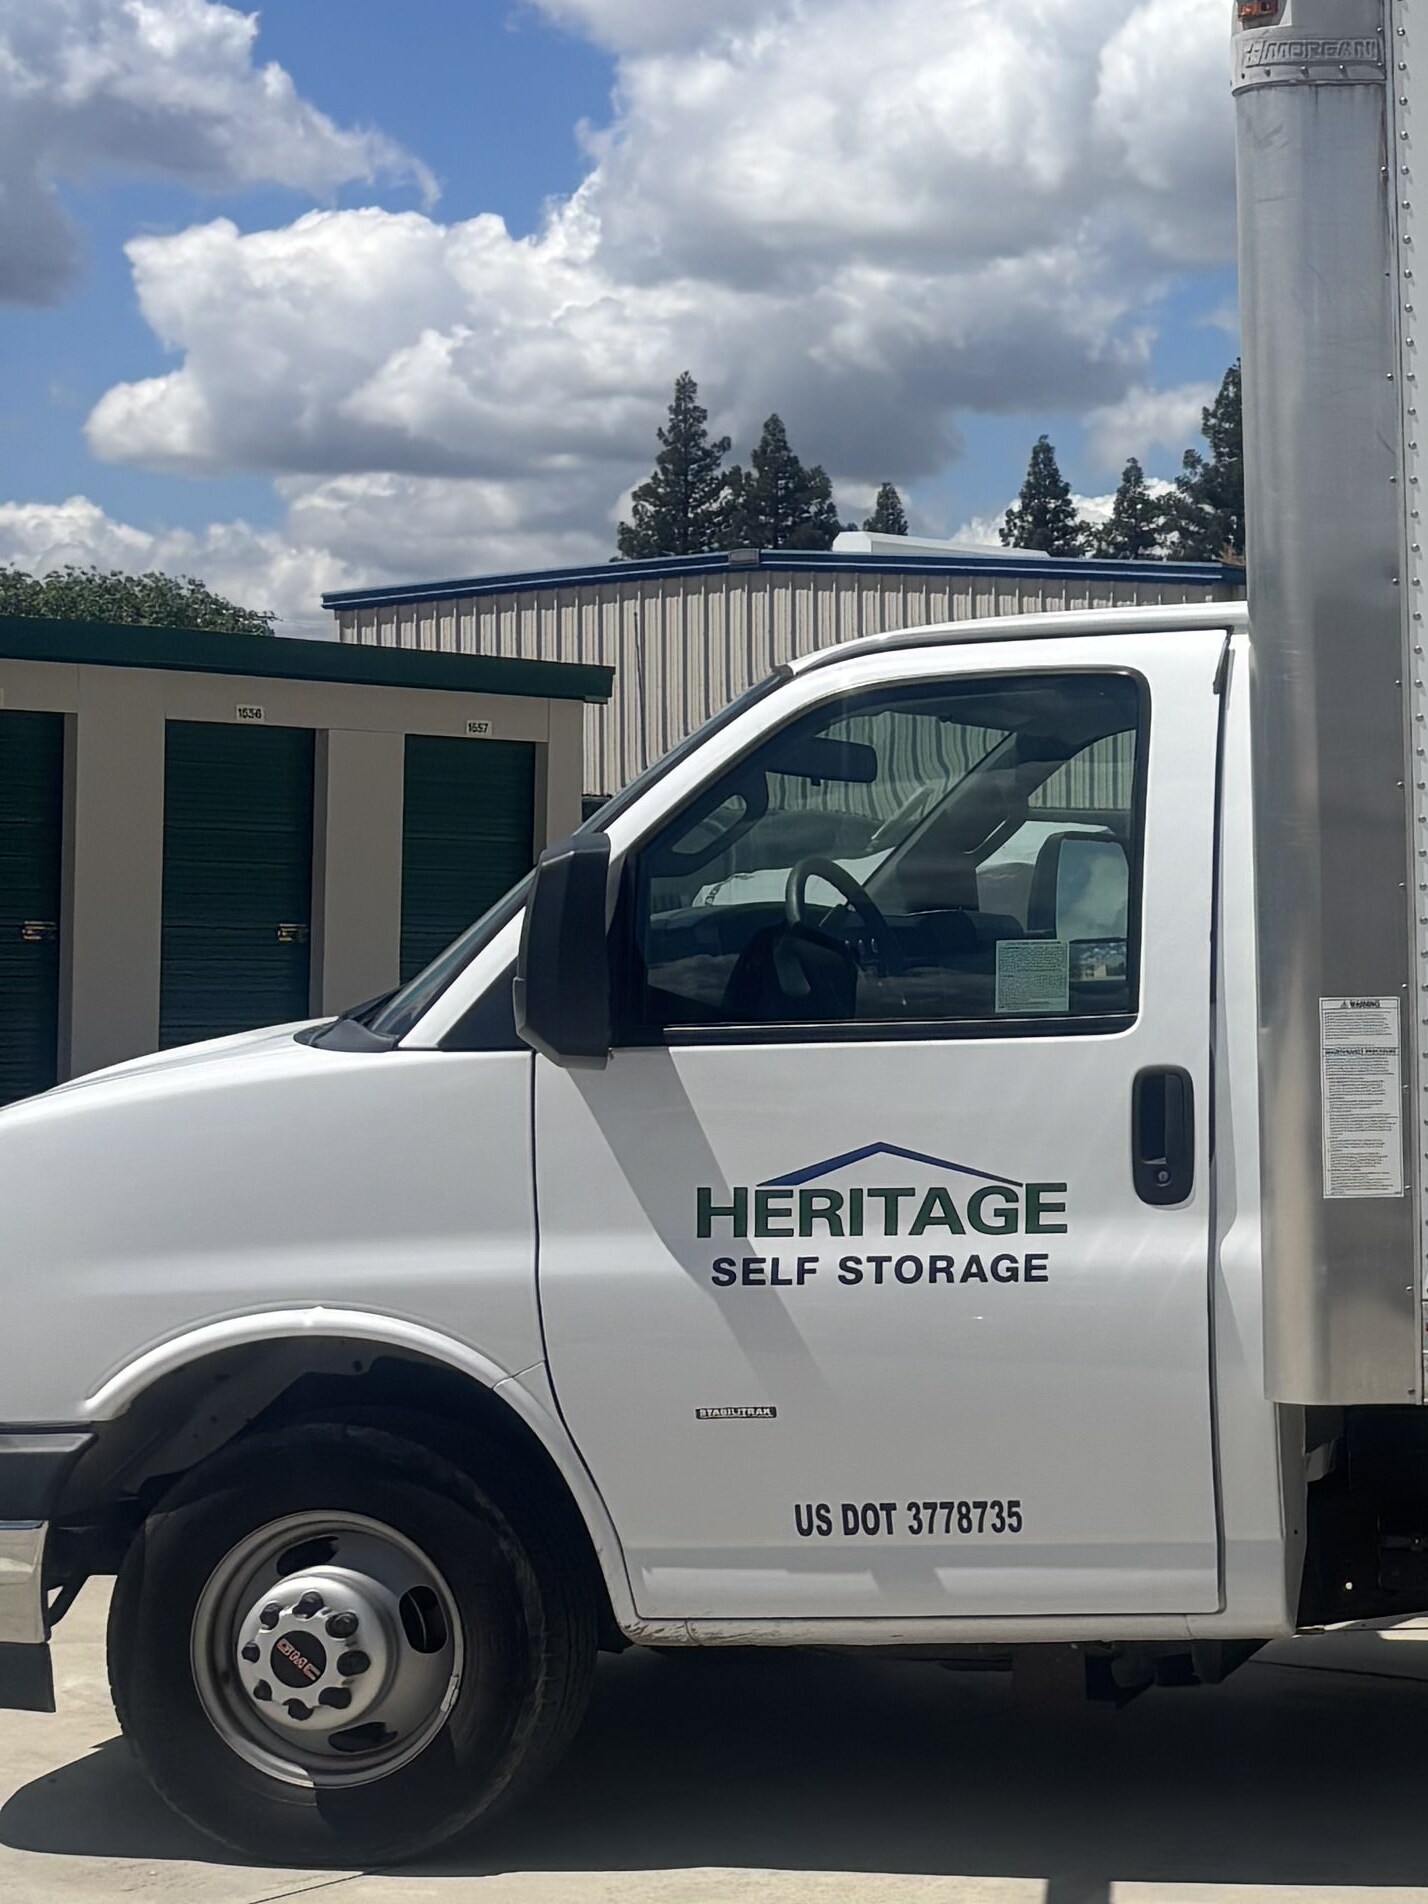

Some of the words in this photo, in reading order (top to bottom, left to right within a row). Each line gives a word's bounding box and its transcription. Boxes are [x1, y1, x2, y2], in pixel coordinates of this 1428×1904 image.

[697, 1182, 1067, 1238] HERITAGE
[712, 1256, 818, 1286] SELF
[838, 1253, 1049, 1285] STORAGE
[795, 1503, 832, 1537] US
[842, 1502, 897, 1536] DOT
[907, 1500, 1023, 1535] 3778735
[277, 1638, 320, 1680] GMC
